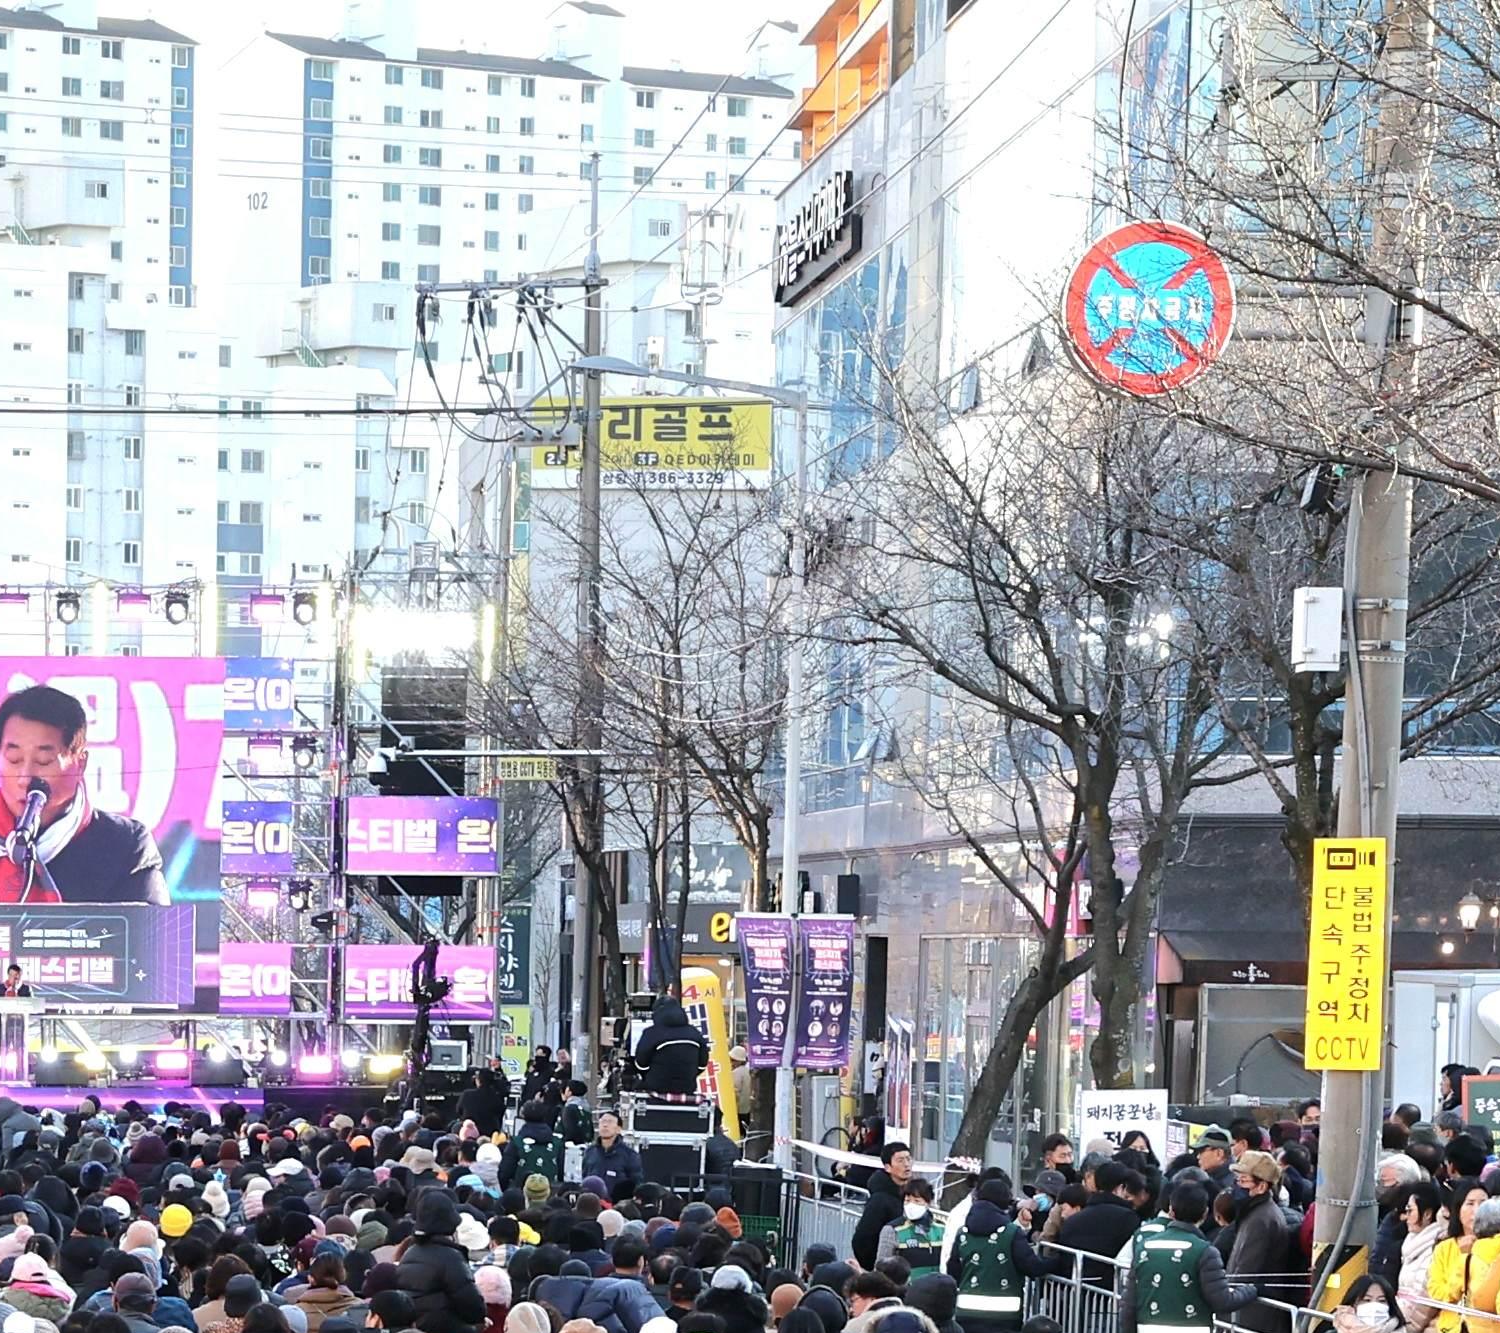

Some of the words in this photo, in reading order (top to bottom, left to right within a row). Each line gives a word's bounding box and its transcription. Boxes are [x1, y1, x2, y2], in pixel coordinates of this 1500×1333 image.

[1353, 885, 1374, 934] 불법
[1317, 886, 1344, 1024] 단속구역
[1315, 1037, 1370, 1061] CCTV
